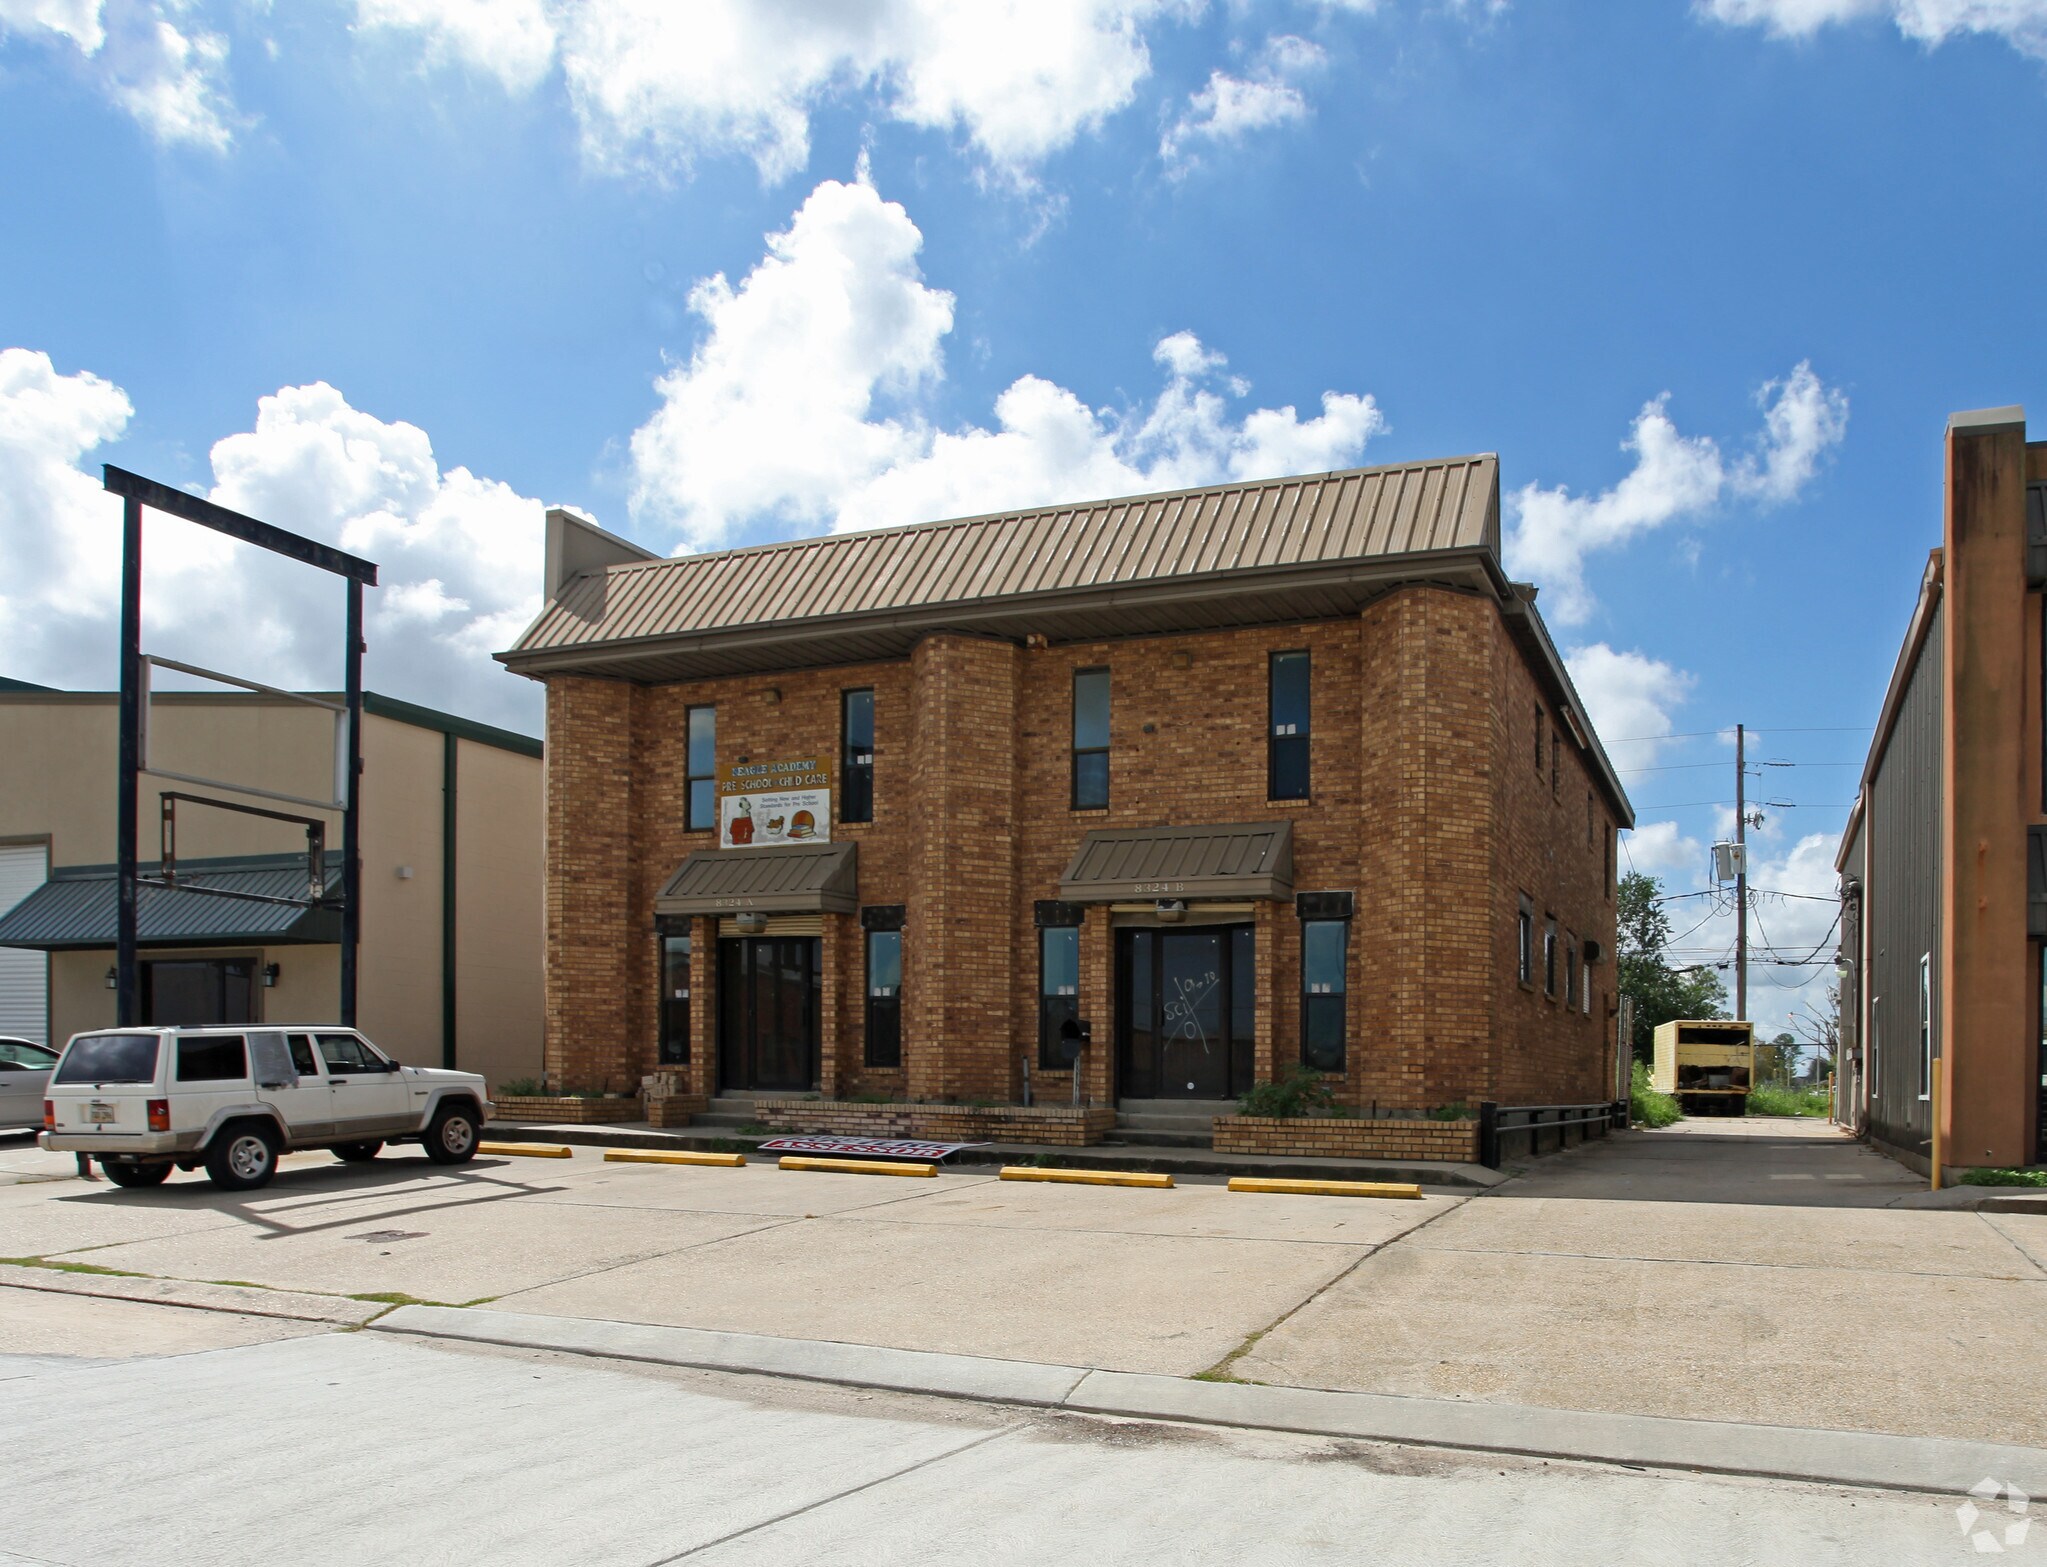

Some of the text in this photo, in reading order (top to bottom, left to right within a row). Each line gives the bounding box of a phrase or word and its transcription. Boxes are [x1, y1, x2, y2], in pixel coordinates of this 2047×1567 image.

[771, 761, 816, 772] ACADEMY
[722, 781, 737, 792] PRE
[741, 778, 772, 790] SCHOOL
[779, 776, 802, 787] CHILD
[805, 773, 828, 785] CARE
[1135, 882, 1184, 893] 8324 B
[716, 898, 754, 907] 8324 A
[771, 1141, 939, 1156] ASSESSOR
